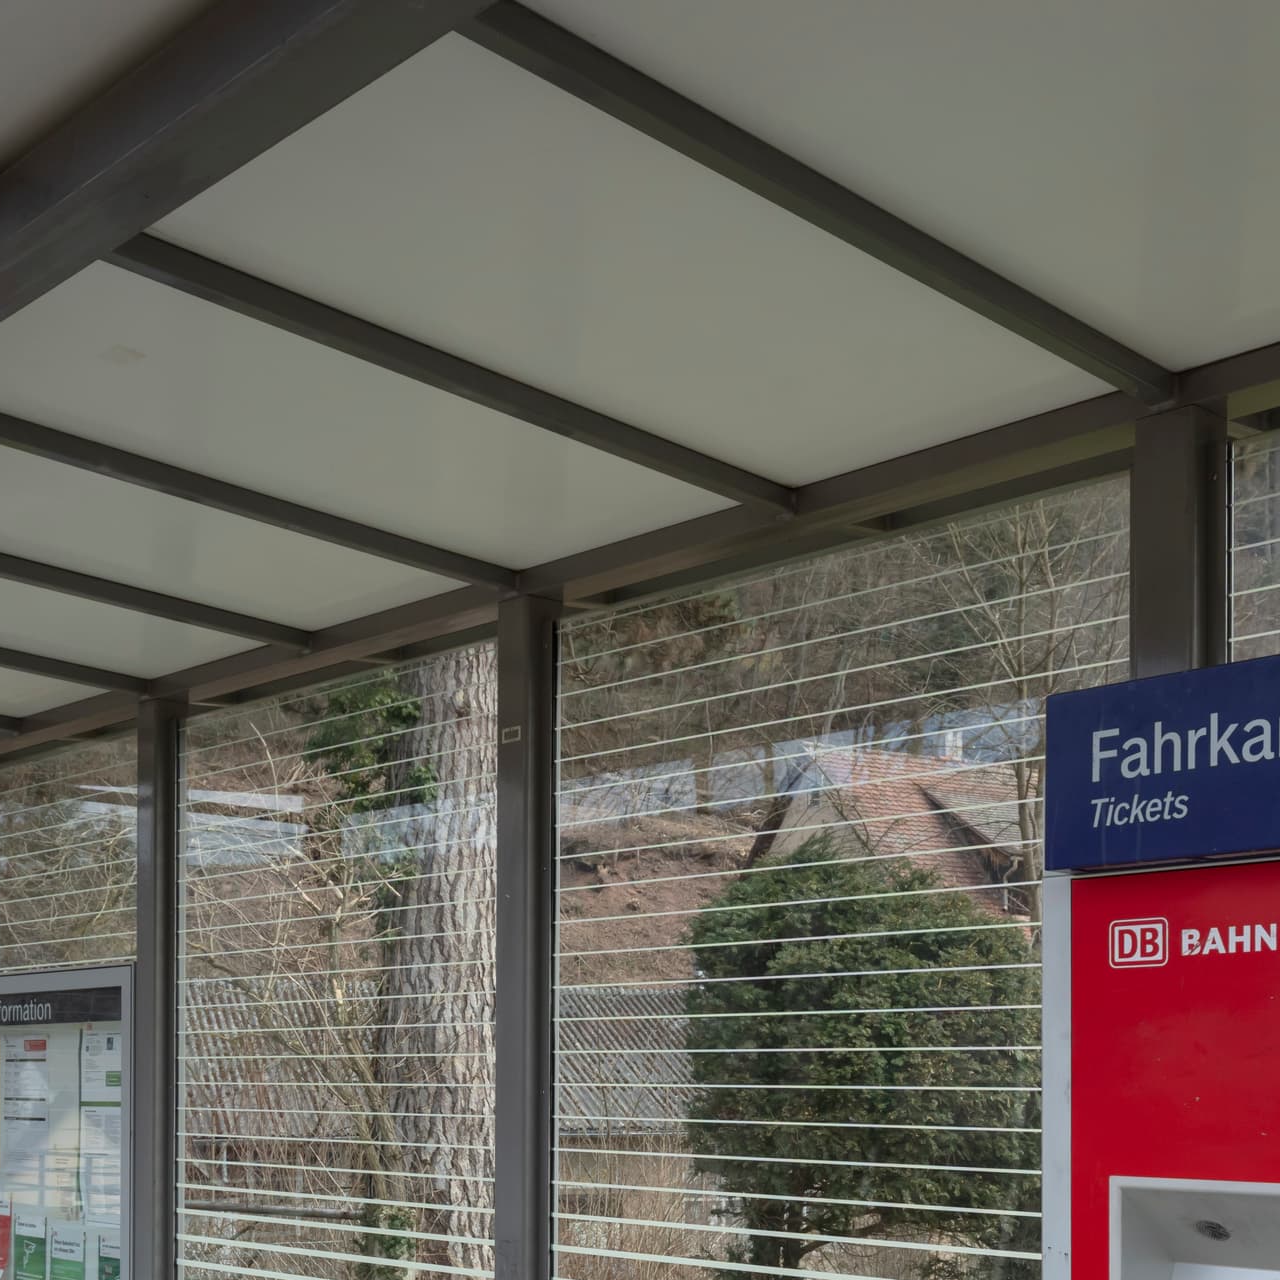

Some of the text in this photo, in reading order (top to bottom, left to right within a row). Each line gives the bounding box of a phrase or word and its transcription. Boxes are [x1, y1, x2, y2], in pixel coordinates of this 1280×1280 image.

[1090, 790, 1189, 828] Tickets
[1115, 922, 1278, 962] DB BAHN
